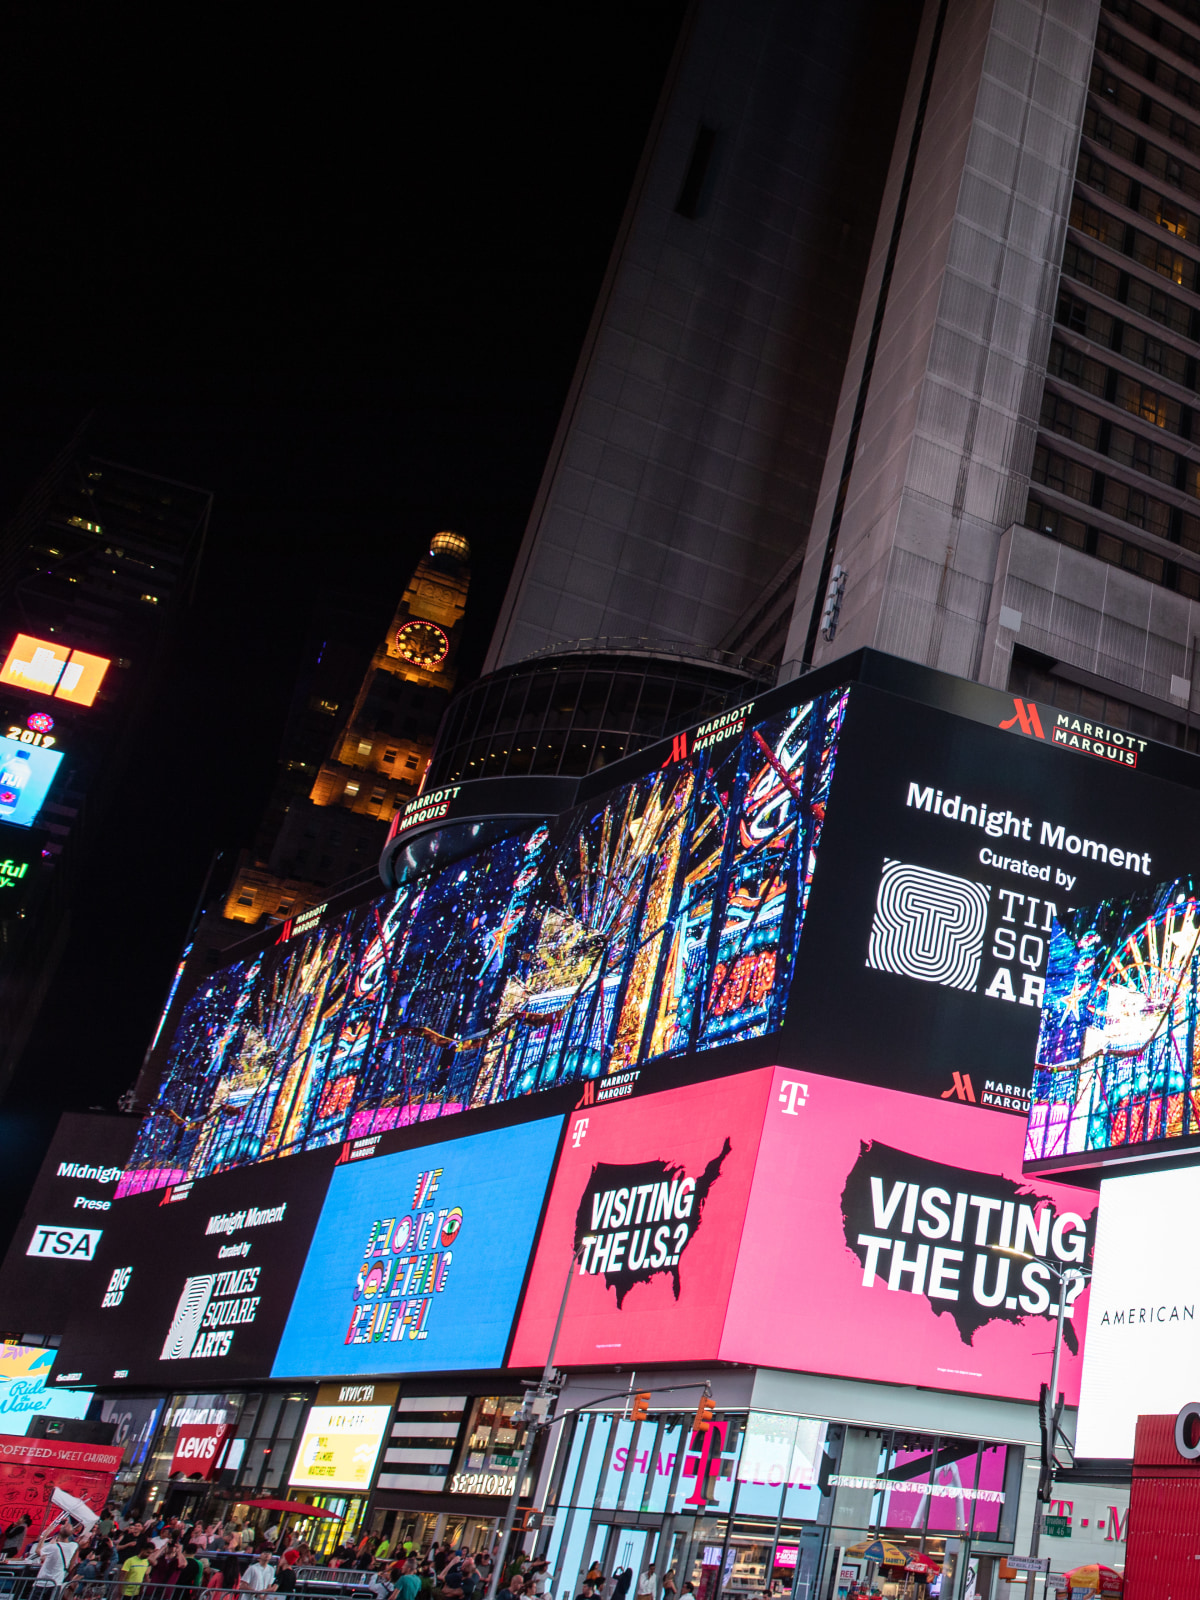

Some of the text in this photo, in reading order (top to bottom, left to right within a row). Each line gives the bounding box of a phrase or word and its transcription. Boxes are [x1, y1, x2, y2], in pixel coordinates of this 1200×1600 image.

[696, 702, 755, 737] MARRIOTT
[1056, 714, 1149, 753] MARRIOTT
[6, 726, 56, 749] 2019
[692, 721, 744, 753] MARQUIS
[1054, 729, 1136, 765] MARQUIS
[404, 786, 462, 816] MARRIOTT
[399, 802, 449, 831] MARQUIS
[906, 782, 1152, 876] Midnight Moment
[0, 859, 29, 879] ful
[979, 847, 1077, 891] Curated by
[296, 903, 328, 925] MARRIOTT
[993, 927, 1050, 971] SQ
[597, 1084, 633, 1101] MARQUIS
[600, 1070, 641, 1088] MARRIOTT
[74, 1196, 112, 1211] Prese
[411, 1168, 444, 1210] WE
[590, 1177, 696, 1231] VISITING
[205, 1202, 287, 1236] Midnight Moment
[363, 1206, 463, 1259] BELONG TO
[869, 1176, 1088, 1264] VISITING
[37, 1231, 92, 1258] TSA
[218, 1241, 252, 1260] Curated by
[578, 1222, 690, 1276] THE U.S.?
[107, 1266, 133, 1292] BIG
[213, 1267, 261, 1297] TIMES
[353, 1250, 453, 1301] SOMETHING
[856, 1233, 1086, 1320] THE U.S.?
[101, 1291, 124, 1308] BOLD
[202, 1297, 261, 1329] SQUARE
[344, 1297, 433, 1345] BEAUTIFUL
[1100, 1304, 1195, 1326] AMERICAN
[191, 1330, 234, 1359] ARTS
[9, 1379, 47, 1397] Ride
[337, 1385, 375, 1402] INVICTA
[57, 1450, 82, 1461] SWEET
[83, 1453, 117, 1465] CHURROS
[451, 1473, 516, 1496] SEPHORA
[1056, 1528, 1064, 1536] 46
